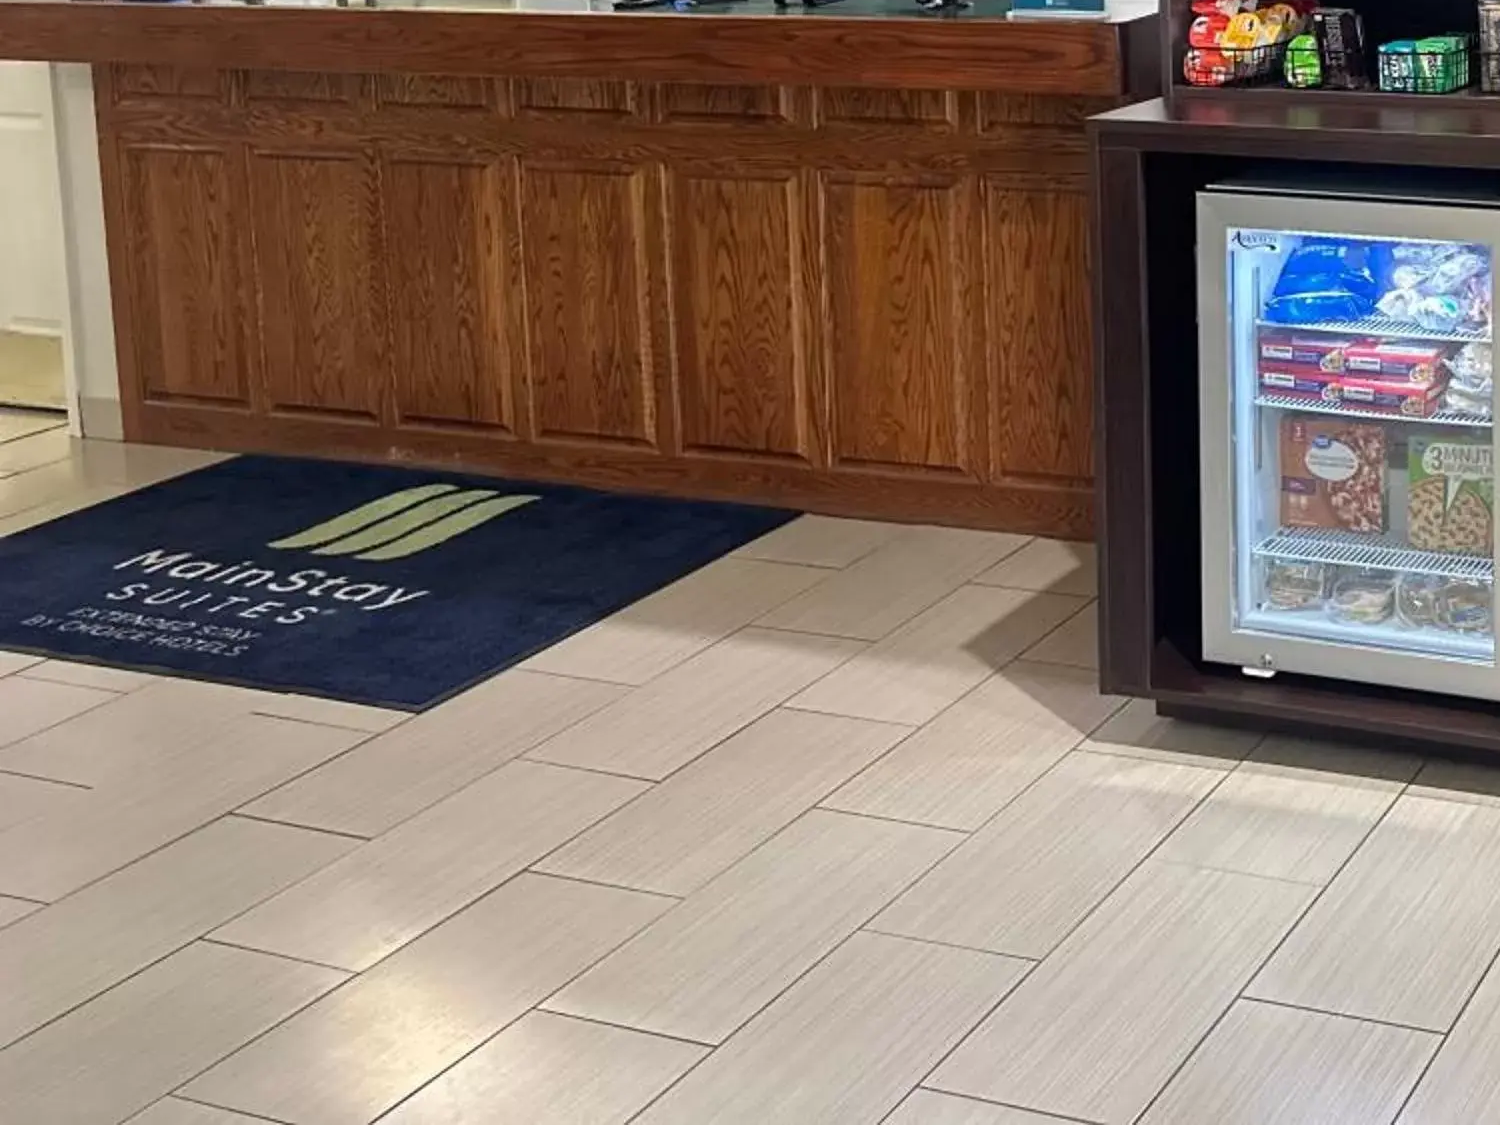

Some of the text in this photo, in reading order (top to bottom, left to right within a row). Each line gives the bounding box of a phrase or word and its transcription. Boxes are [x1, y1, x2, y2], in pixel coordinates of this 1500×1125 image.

[1430, 447, 1443, 470] 3
[114, 549, 431, 610] MainStay
[107, 582, 322, 625] SUITES
